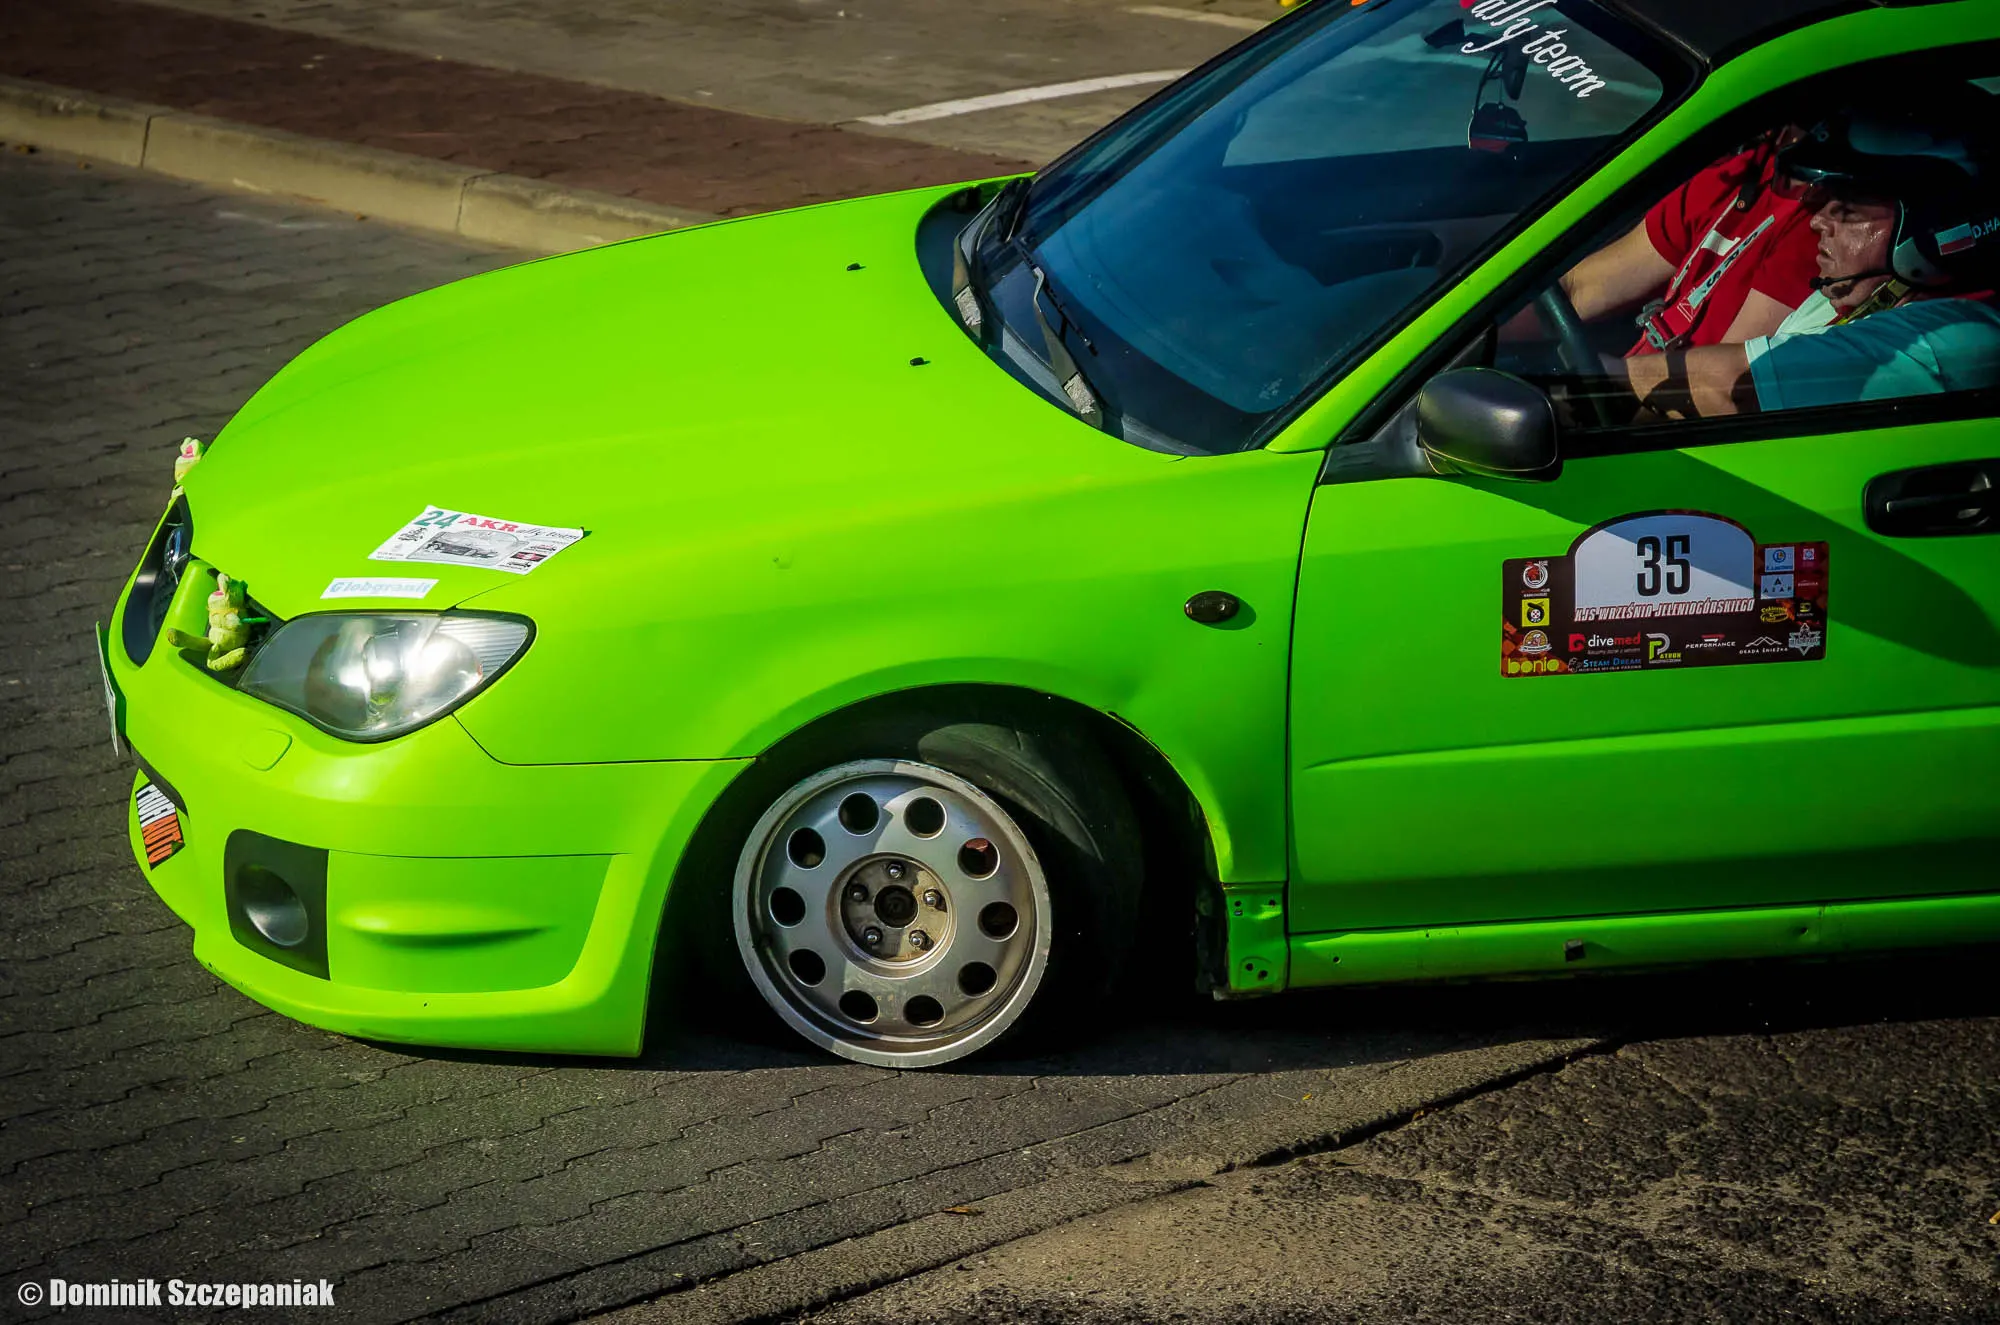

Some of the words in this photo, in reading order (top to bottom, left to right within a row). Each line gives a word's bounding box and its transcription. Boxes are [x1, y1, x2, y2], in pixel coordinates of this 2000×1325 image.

[1460, 0, 1558, 53] ally
[1522, 29, 1606, 98] team
[414, 510, 462, 529] 24
[1636, 534, 1691, 597] 35
[1587, 631, 1641, 647] divemed
[1685, 641, 1736, 649] PERFORMANCE
